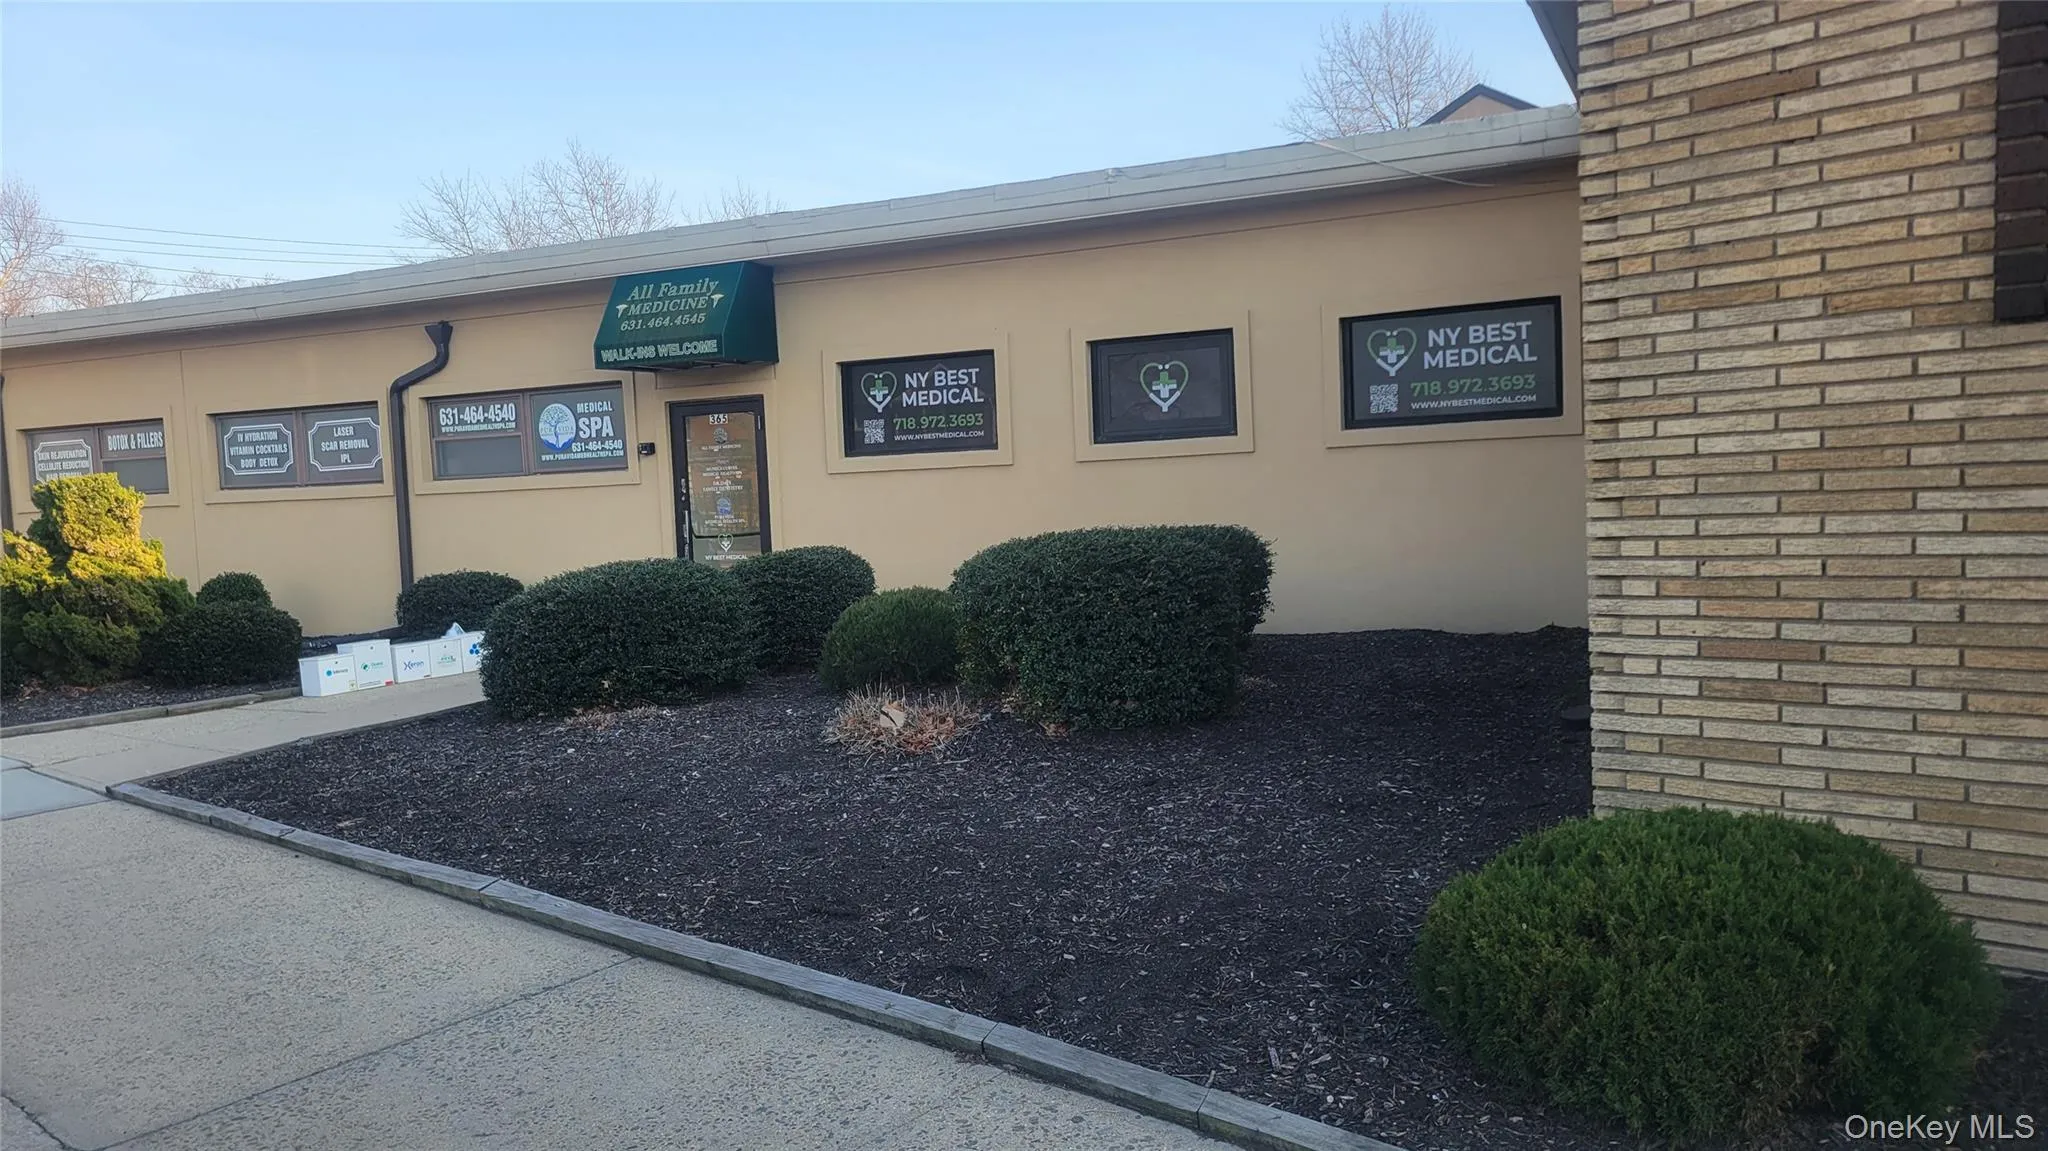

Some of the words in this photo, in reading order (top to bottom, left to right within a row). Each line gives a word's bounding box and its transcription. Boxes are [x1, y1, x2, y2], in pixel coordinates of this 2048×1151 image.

[627, 283, 654, 301] All
[657, 277, 719, 297] Family
[627, 296, 709, 316] MEDICINE
[620, 312, 706, 331] 631.464.4545
[1428, 327, 1461, 348] NY
[1469, 321, 1532, 345] BEST
[600, 345, 656, 362] WALK-INS
[657, 339, 718, 357] WELCOME
[1423, 343, 1537, 370] MEDICAL
[904, 371, 928, 388] NY
[934, 368, 980, 386] BEST
[1410, 374, 1536, 397] 718.972.3693
[902, 387, 984, 407] MEDICAL
[1411, 393, 1537, 410] WWW.NYBESTMEDICAL.COM
[439, 403, 516, 426] 631-464-4540
[576, 401, 613, 413] MEDICAL
[578, 415, 614, 439] SPA
[710, 414, 727, 424] 365
[893, 413, 983, 430] 718.972.3693
[333, 425, 354, 437] LASER
[894, 430, 985, 441] WWW.NYBESTMEDICAL.COM
[107, 434, 130, 451] BOTOX
[130, 433, 136, 450] &
[136, 431, 164, 449] FILLERS
[255, 443, 288, 455] COCKTAILS
[321, 441, 338, 451] SCAR
[339, 438, 370, 450] REMOVAL
[571, 440, 623, 453] 631-464-4540
[340, 453, 351, 463] IPL
